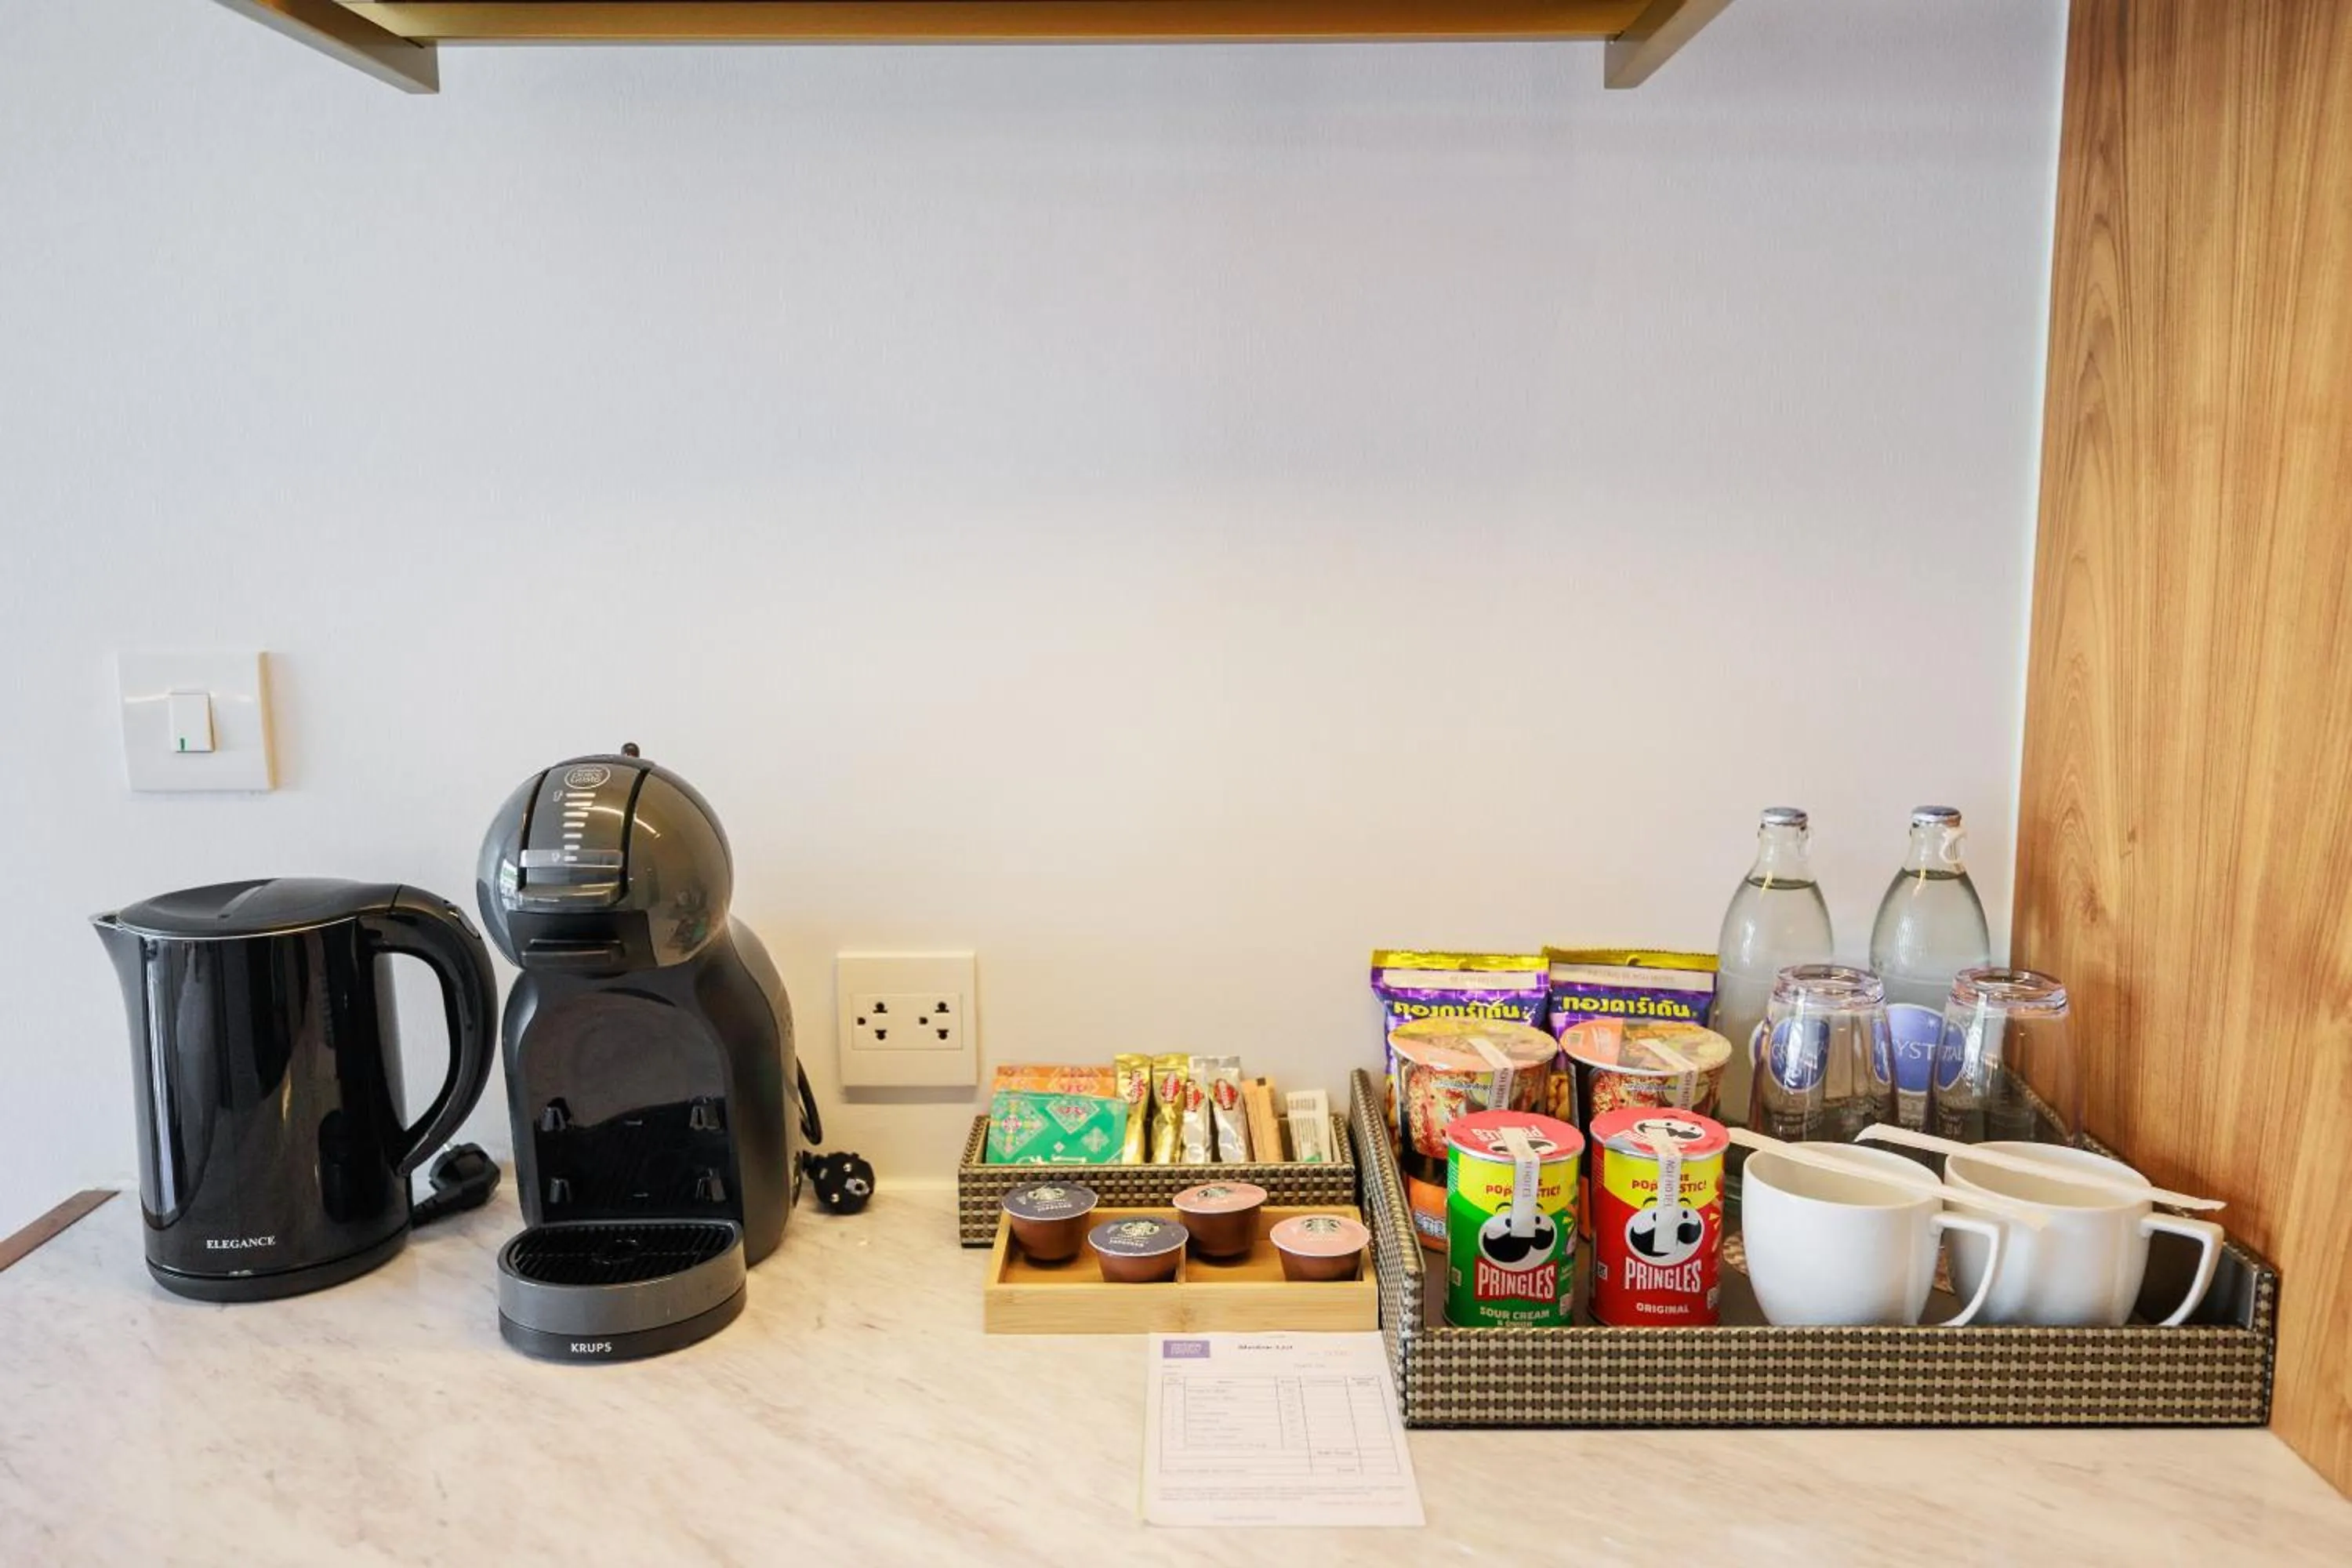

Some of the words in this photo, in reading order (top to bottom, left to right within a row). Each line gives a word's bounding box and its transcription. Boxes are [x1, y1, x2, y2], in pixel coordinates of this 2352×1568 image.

[206, 1236, 276, 1249] ELEGANCE
[1478, 1261, 1555, 1299] PRINGLES
[1624, 1256, 1702, 1293] PRINGLES
[1479, 1305, 1510, 1319] SOUR
[1513, 1308, 1550, 1320] CREAM
[1635, 1302, 1690, 1314] ORIGINAL
[571, 1342, 612, 1352] KRUPS
